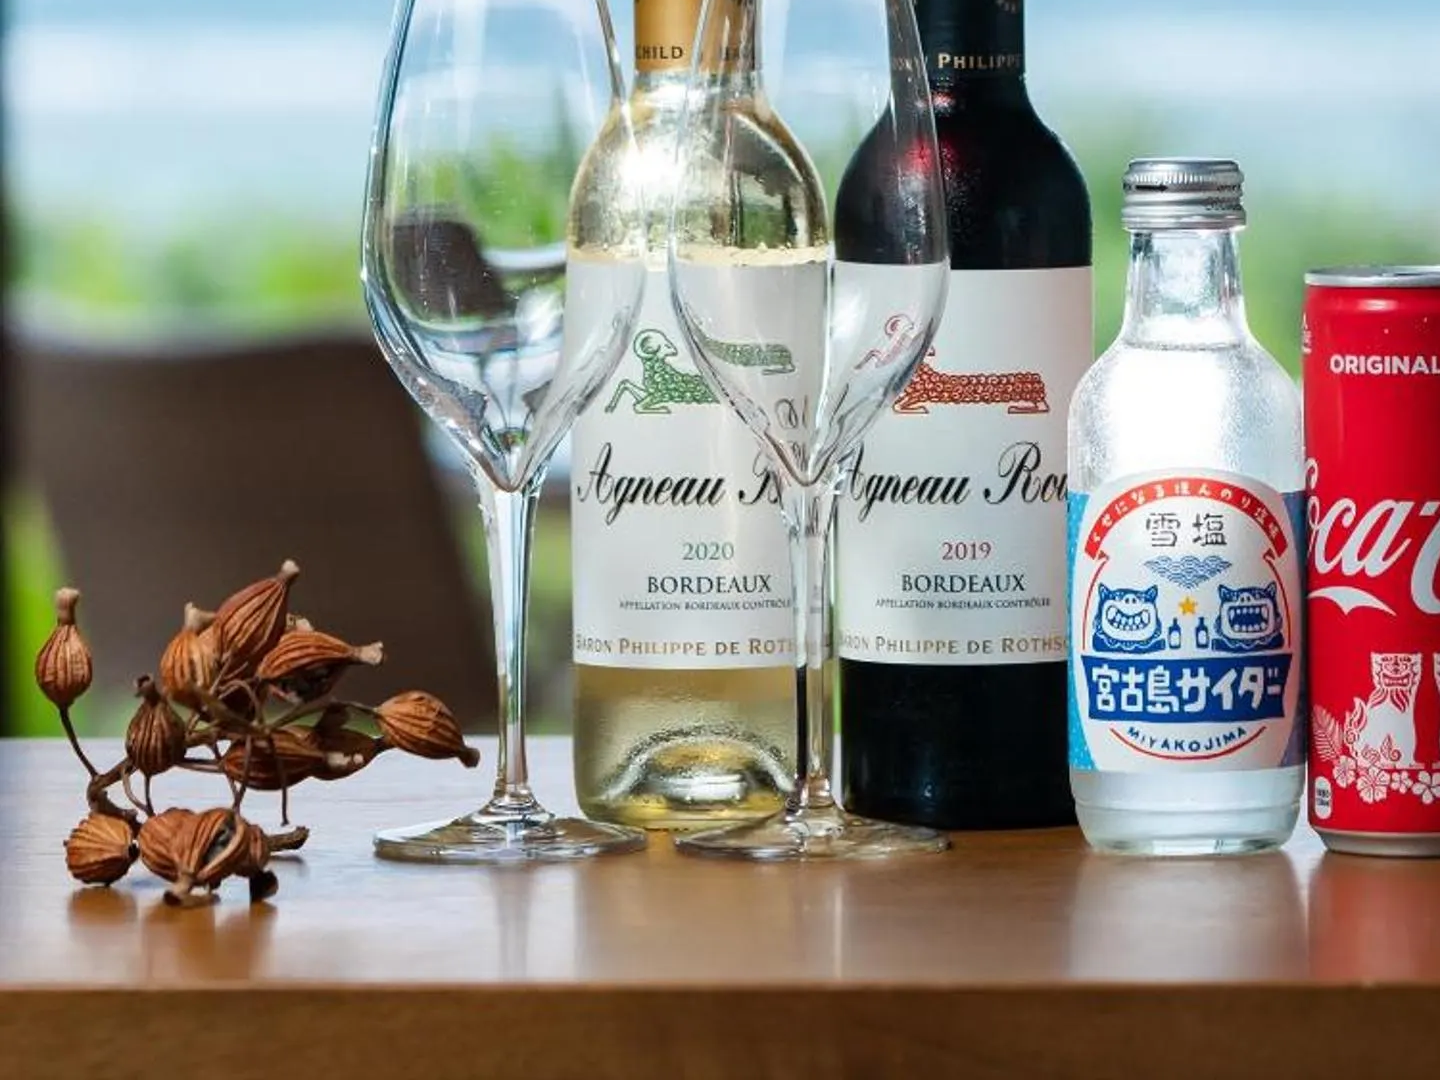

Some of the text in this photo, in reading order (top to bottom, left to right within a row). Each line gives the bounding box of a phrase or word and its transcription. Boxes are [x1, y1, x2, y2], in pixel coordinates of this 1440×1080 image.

[577, 442, 724, 525] Agneau
[1146, 513, 1227, 547] 雪塩
[683, 542, 734, 561] 2020
[942, 542, 992, 561] 2019
[648, 575, 771, 594] BORDEAUX
[901, 574, 1025, 593] BORDEAUX
[619, 637, 706, 656] PHILIPPE
[715, 640, 740, 655] DE
[875, 636, 959, 654] PHILIPPE
[967, 639, 993, 654] DE
[1092, 665, 1282, 714] 宮古島サイダー
[1127, 726, 1247, 752] MIYAKOJIMA
